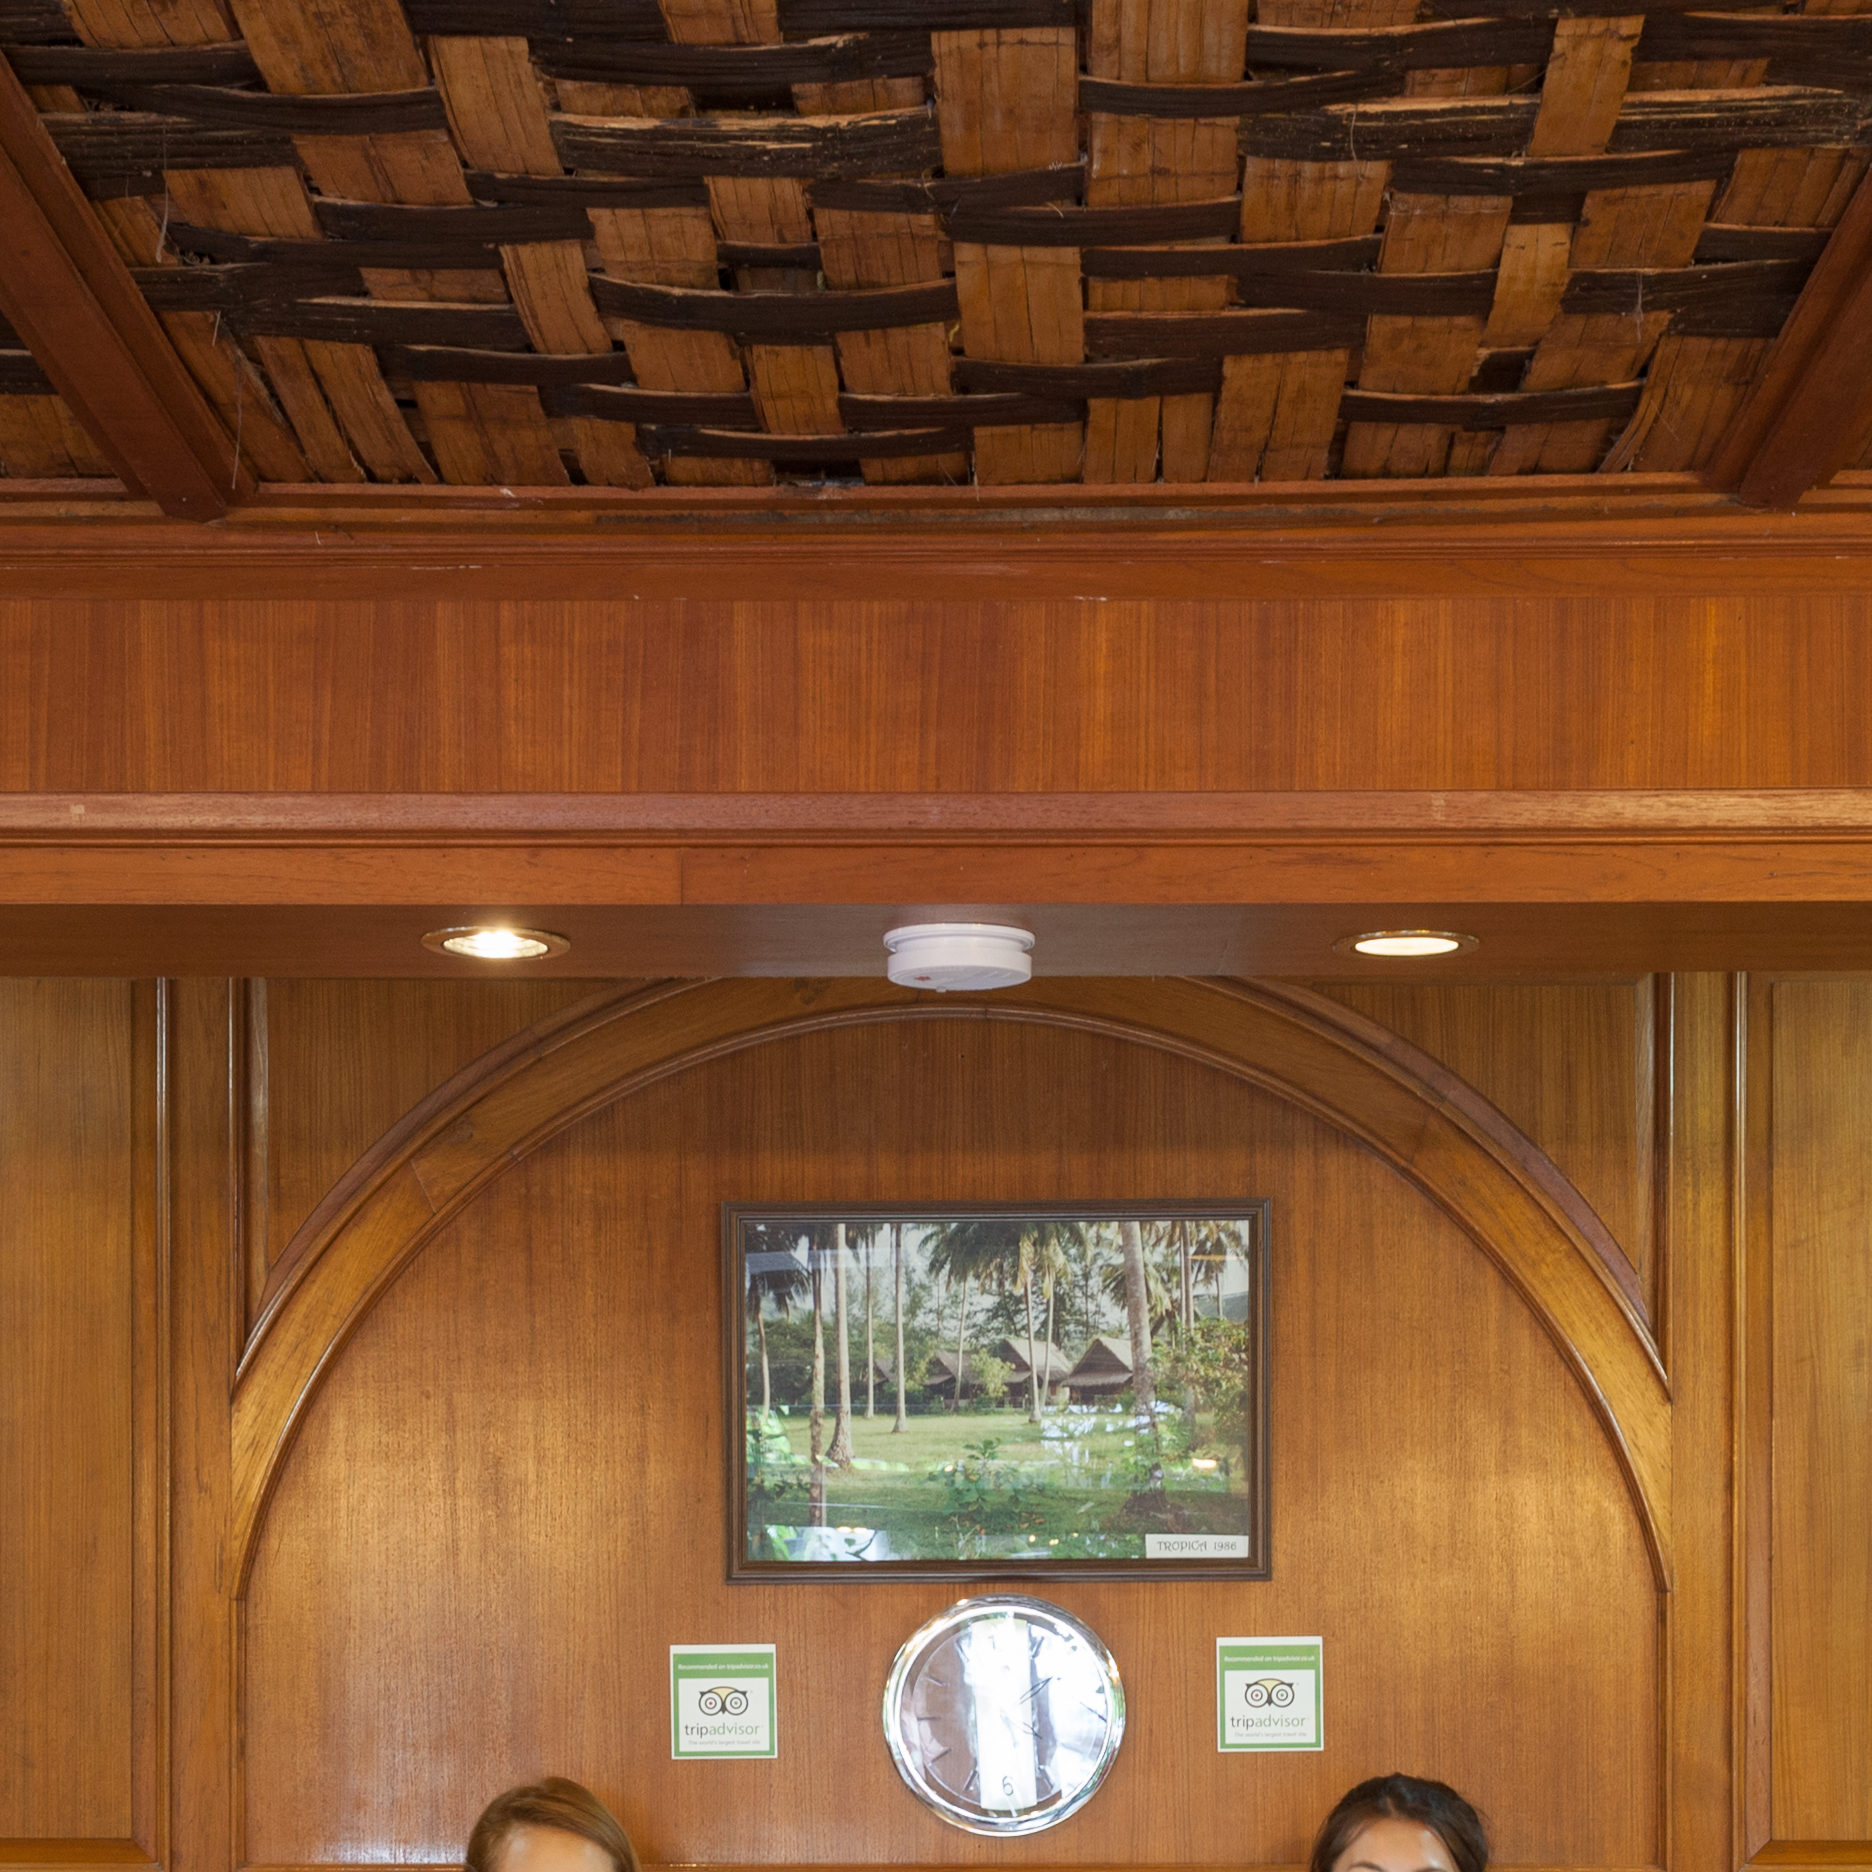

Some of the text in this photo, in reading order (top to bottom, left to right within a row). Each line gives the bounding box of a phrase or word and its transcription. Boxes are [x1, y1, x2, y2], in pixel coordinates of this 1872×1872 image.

[1157, 1540, 1237, 1552] TROPICA 1986
[1231, 1715, 1306, 1730] tripadvisor
[685, 1723, 760, 1738] tripadvisor
